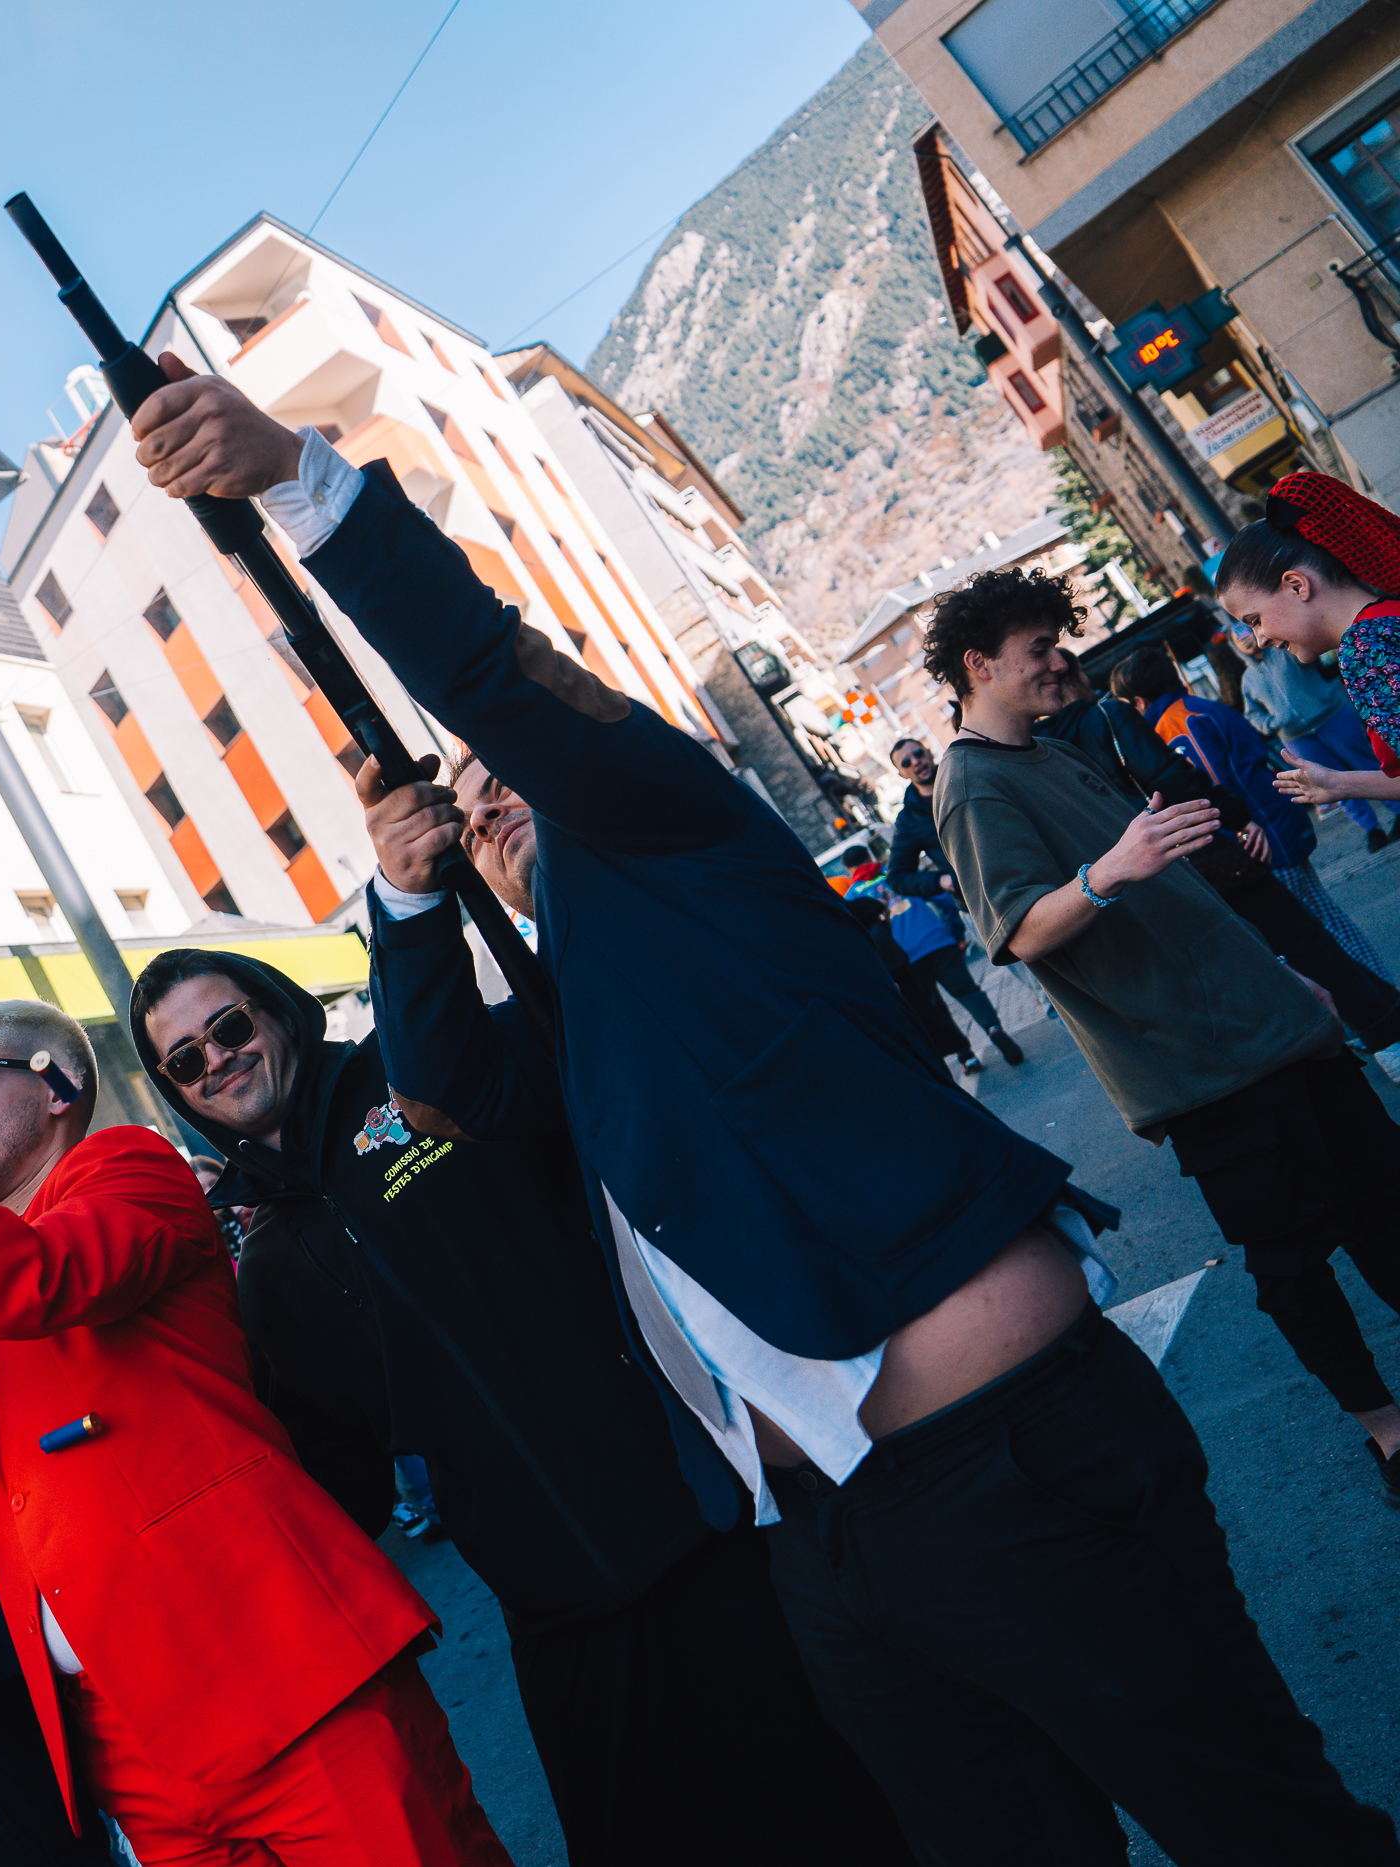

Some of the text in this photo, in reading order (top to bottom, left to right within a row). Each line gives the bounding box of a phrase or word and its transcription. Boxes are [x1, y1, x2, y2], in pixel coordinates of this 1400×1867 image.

[383, 1141, 454, 1203] FESTES D'ENCAMP
[384, 1136, 435, 1182] COMISSIÓ DE
